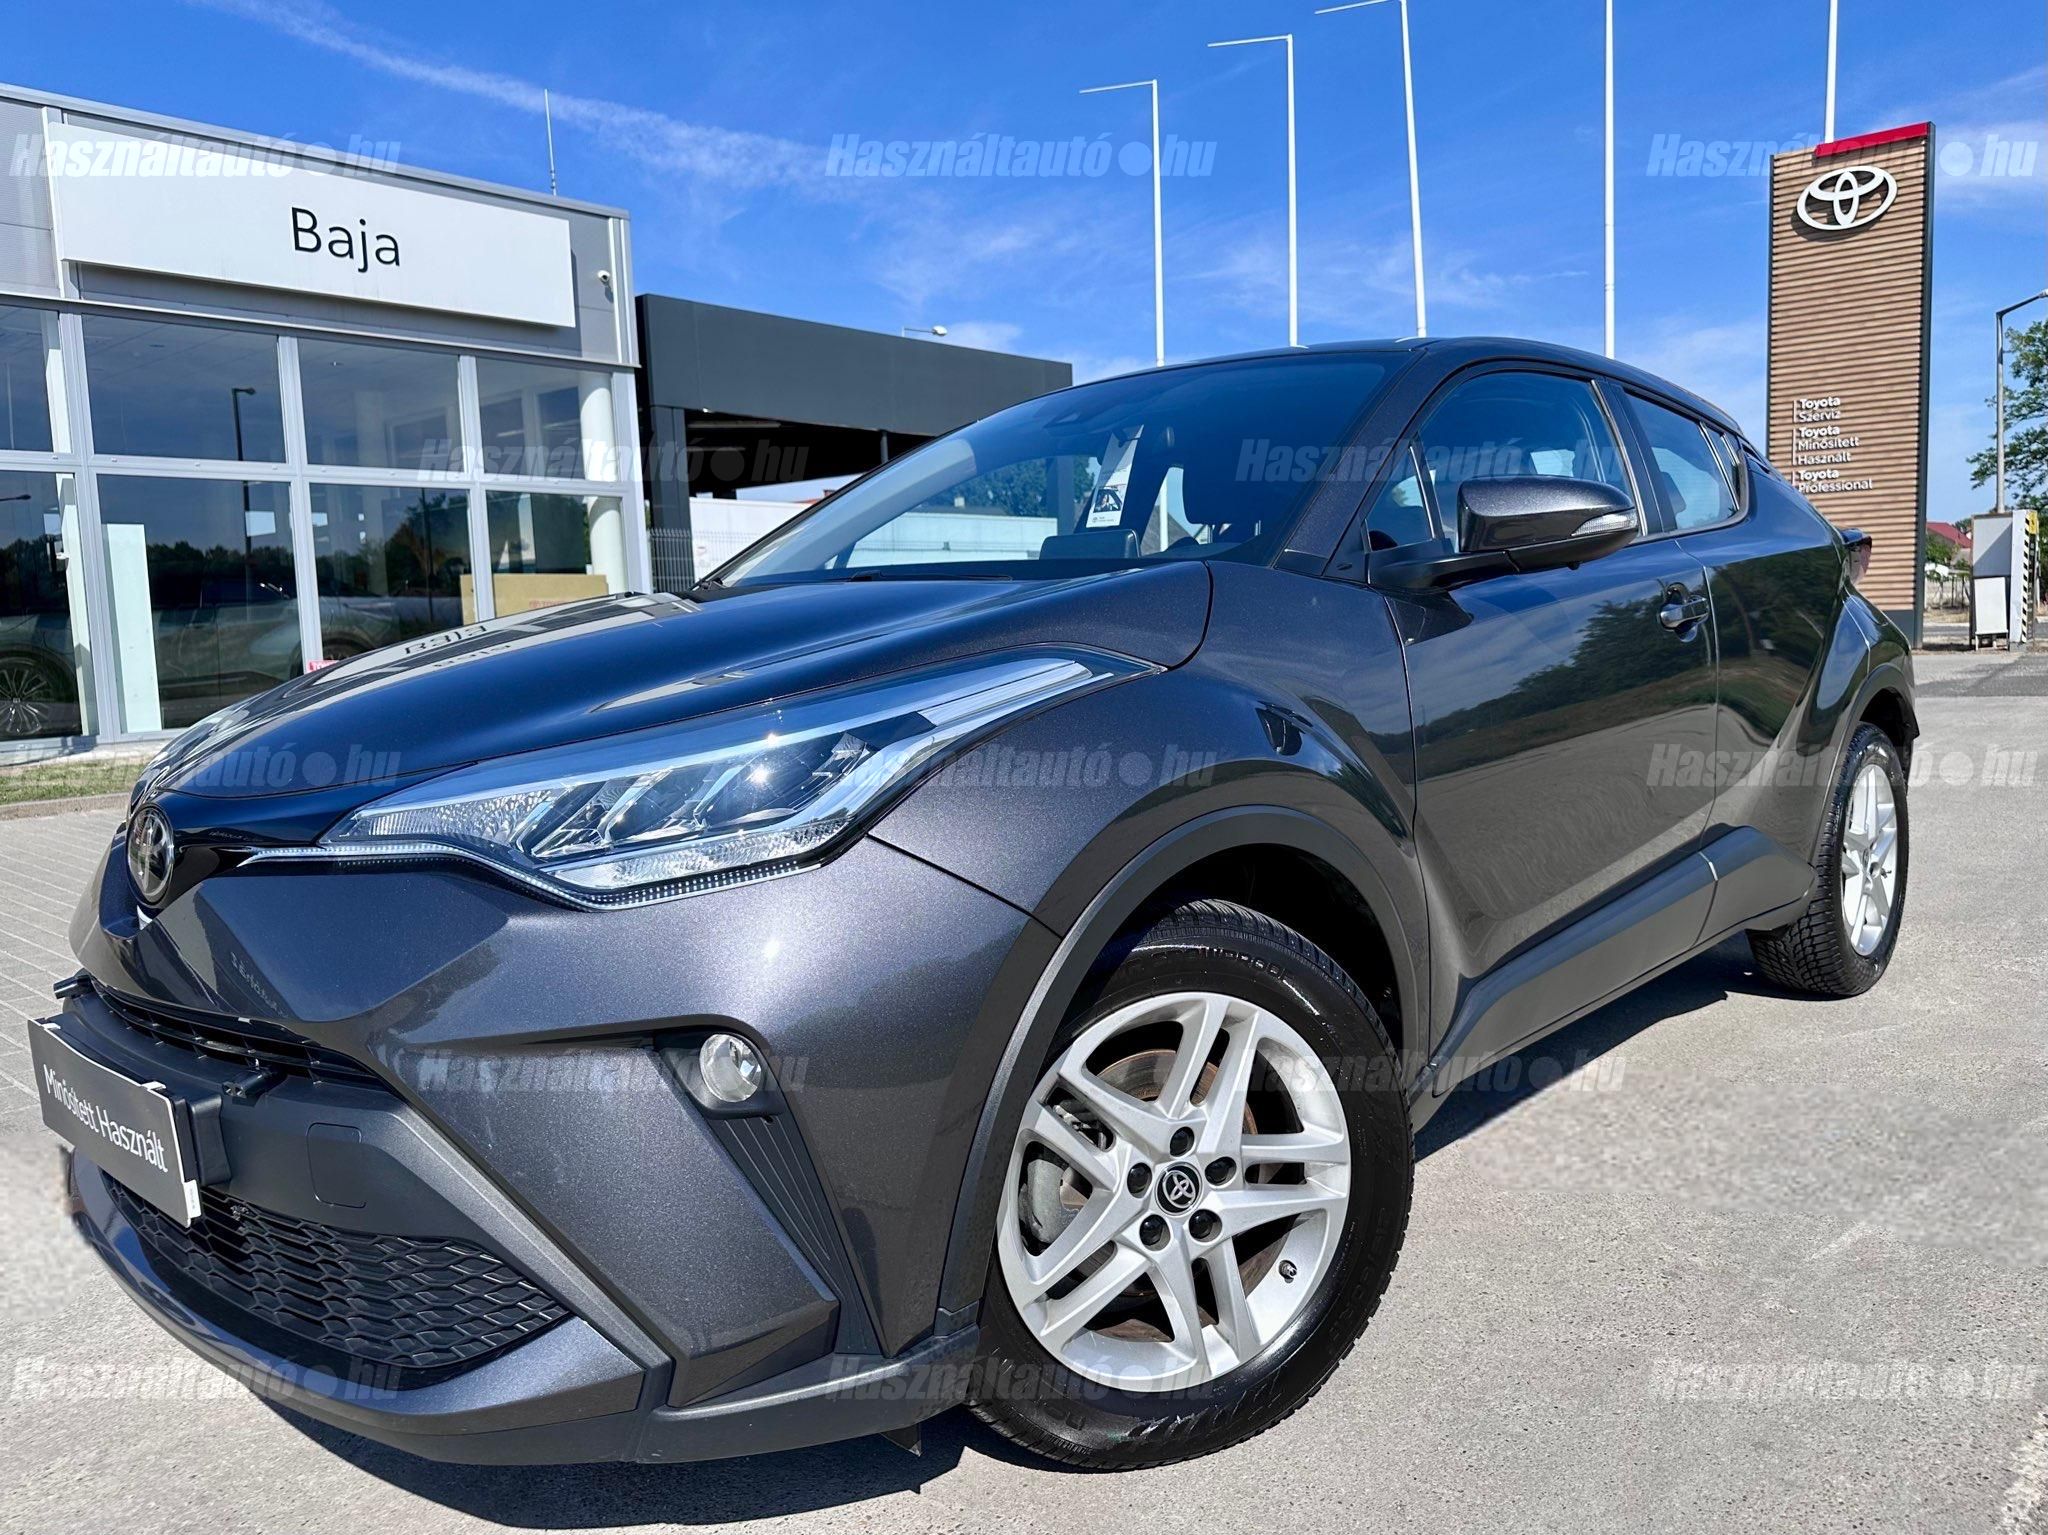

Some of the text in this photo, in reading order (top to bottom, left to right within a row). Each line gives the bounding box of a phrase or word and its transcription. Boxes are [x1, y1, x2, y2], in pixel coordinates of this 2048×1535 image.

[290, 207, 401, 273] Baja
[1800, 396, 1841, 410] Toyota
[1799, 409, 1841, 423] Szerviz
[1799, 425, 1841, 438] Toyota
[1798, 469, 1840, 482] Toyota
[1799, 478, 1873, 493] Professional
[96, 1105, 169, 1173] Használt
